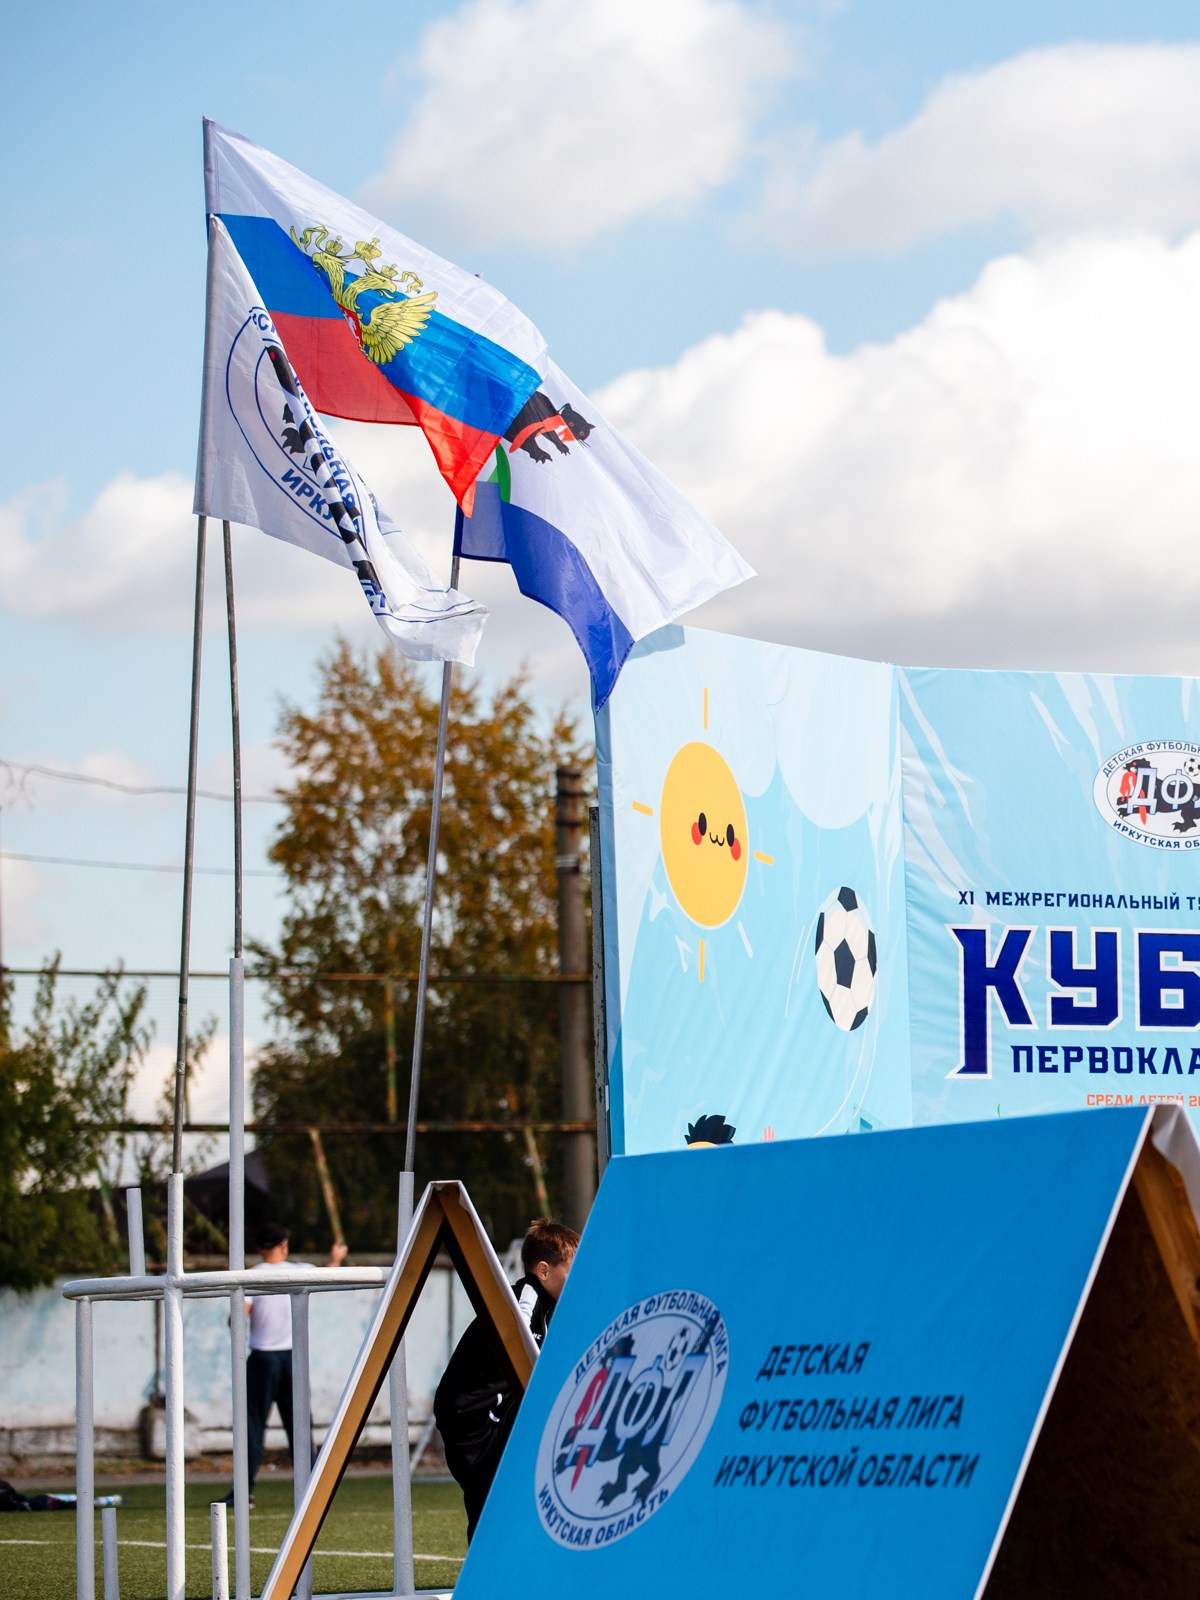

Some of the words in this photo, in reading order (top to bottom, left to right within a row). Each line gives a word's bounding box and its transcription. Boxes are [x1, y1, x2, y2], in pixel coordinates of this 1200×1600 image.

[1102, 745, 1144, 778] ДЕТСКАЯ
[1112, 820, 1180, 849] ИРКУТСКАЯ
[985, 890, 1180, 910] МЕЖРЕГИОНАЛЬНЫЙ
[1086, 1094, 1134, 1107] СРЕДИ
[575, 1303, 641, 1385] ДЕТСКАЯ
[643, 1291, 719, 1327] ФУТБОЛЬНАЯ
[713, 1322, 727, 1378] ЛИГА
[756, 1341, 871, 1381] ДЕТСКАЯ
[565, 1354, 708, 1468] ДФЛ
[738, 1396, 901, 1432] ФУТБОЛЬНАЯ
[896, 1394, 965, 1429] ЛИГА
[713, 1445, 860, 1488] ИРКУТСКОЙ
[857, 1452, 980, 1488] ОБЛАСТИ
[538, 1483, 591, 1546] ИРКУТСКАЯ
[595, 1488, 669, 1545] ОБЛАСТЬ
